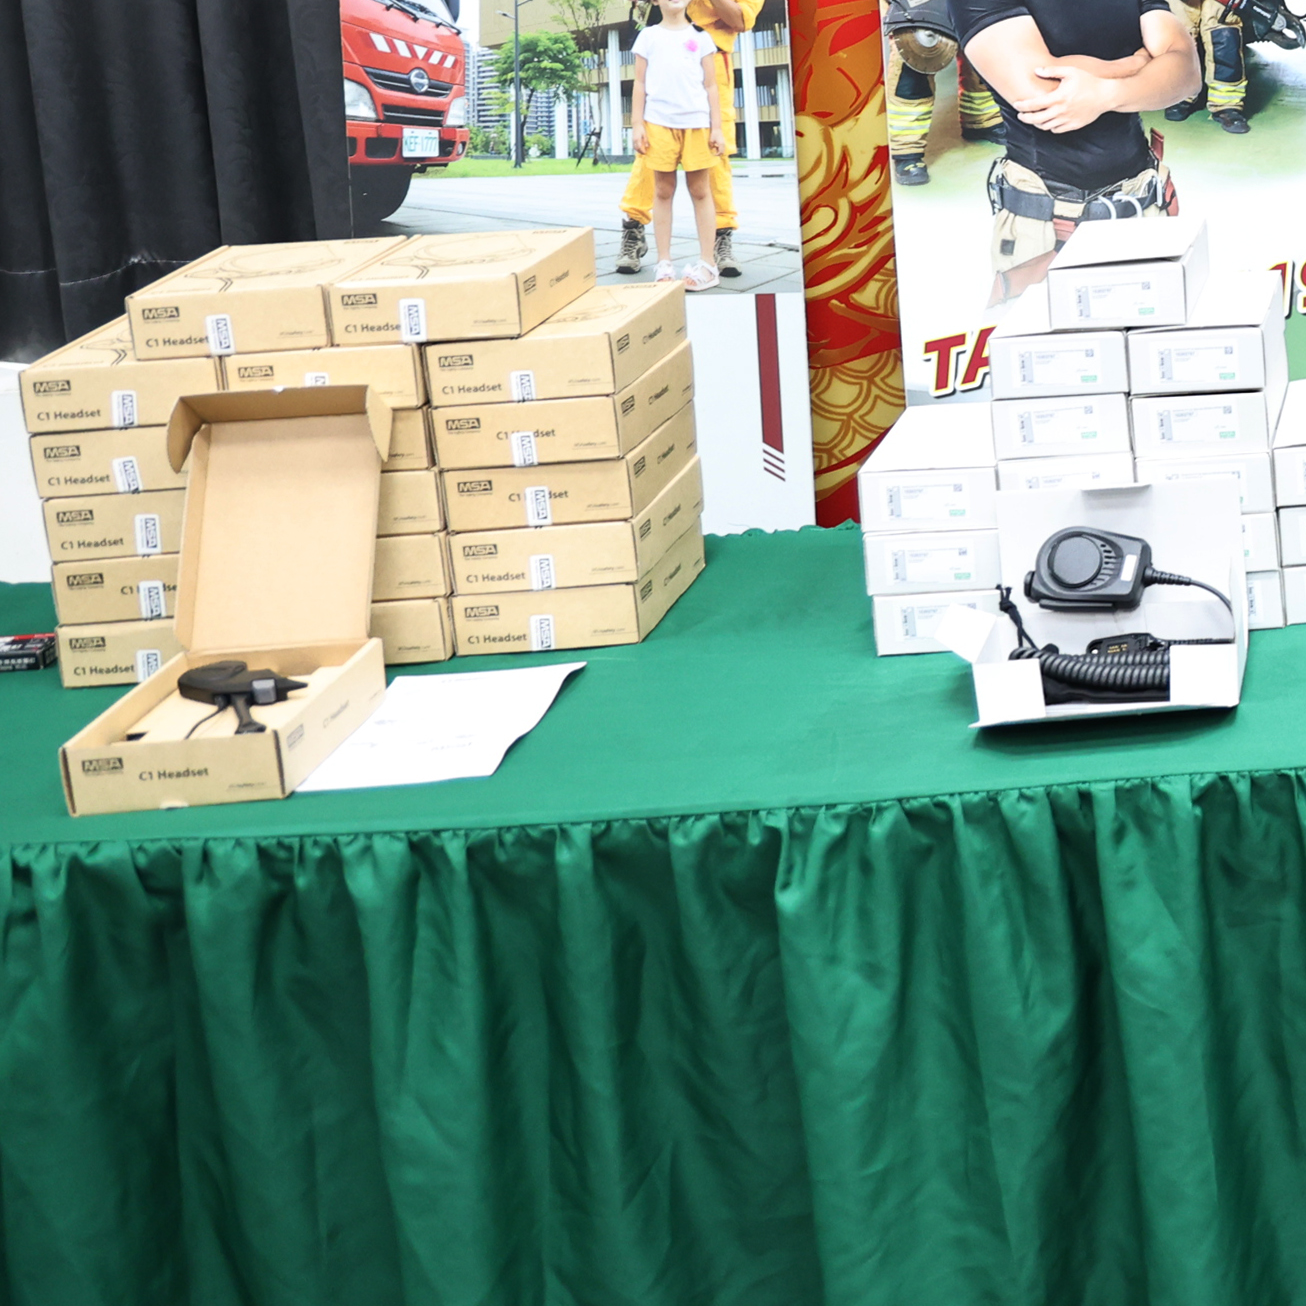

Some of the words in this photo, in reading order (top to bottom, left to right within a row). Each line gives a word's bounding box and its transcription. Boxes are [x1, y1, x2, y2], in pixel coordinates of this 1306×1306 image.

[341, 293, 378, 306] MSA
[142, 306, 180, 320] MSA
[345, 324, 358, 334] C1
[146, 337, 159, 348] C1
[438, 354, 474, 368] MSA
[238, 366, 274, 378] MSA
[33, 380, 71, 394] MSA
[442, 385, 455, 395] C1
[458, 382, 502, 394] Headset
[37, 411, 50, 421] C1
[54, 408, 101, 420] Headset
[446, 417, 481, 431] MSA
[496, 431, 509, 441] C1
[44, 445, 81, 459] MSA
[48, 477, 61, 487] C1
[64, 473, 110, 485] Headset
[457, 479, 493, 493] MSA
[508, 493, 521, 503] C1
[56, 509, 94, 523] MSA
[61, 541, 74, 551] C1
[77, 538, 124, 549] Headset
[463, 544, 498, 557] MSA
[66, 573, 104, 587] MSA
[466, 574, 479, 584] C1
[482, 571, 525, 583] Headset
[121, 586, 134, 595] C1
[465, 605, 499, 618] MSA
[69, 636, 106, 650] MSA
[468, 635, 481, 645] C1
[484, 632, 527, 644] Headset
[74, 667, 86, 676] C1
[90, 664, 135, 675] Headset
[82, 757, 124, 774] MSA
[139, 771, 153, 782] C1
[158, 767, 209, 781] Headset
